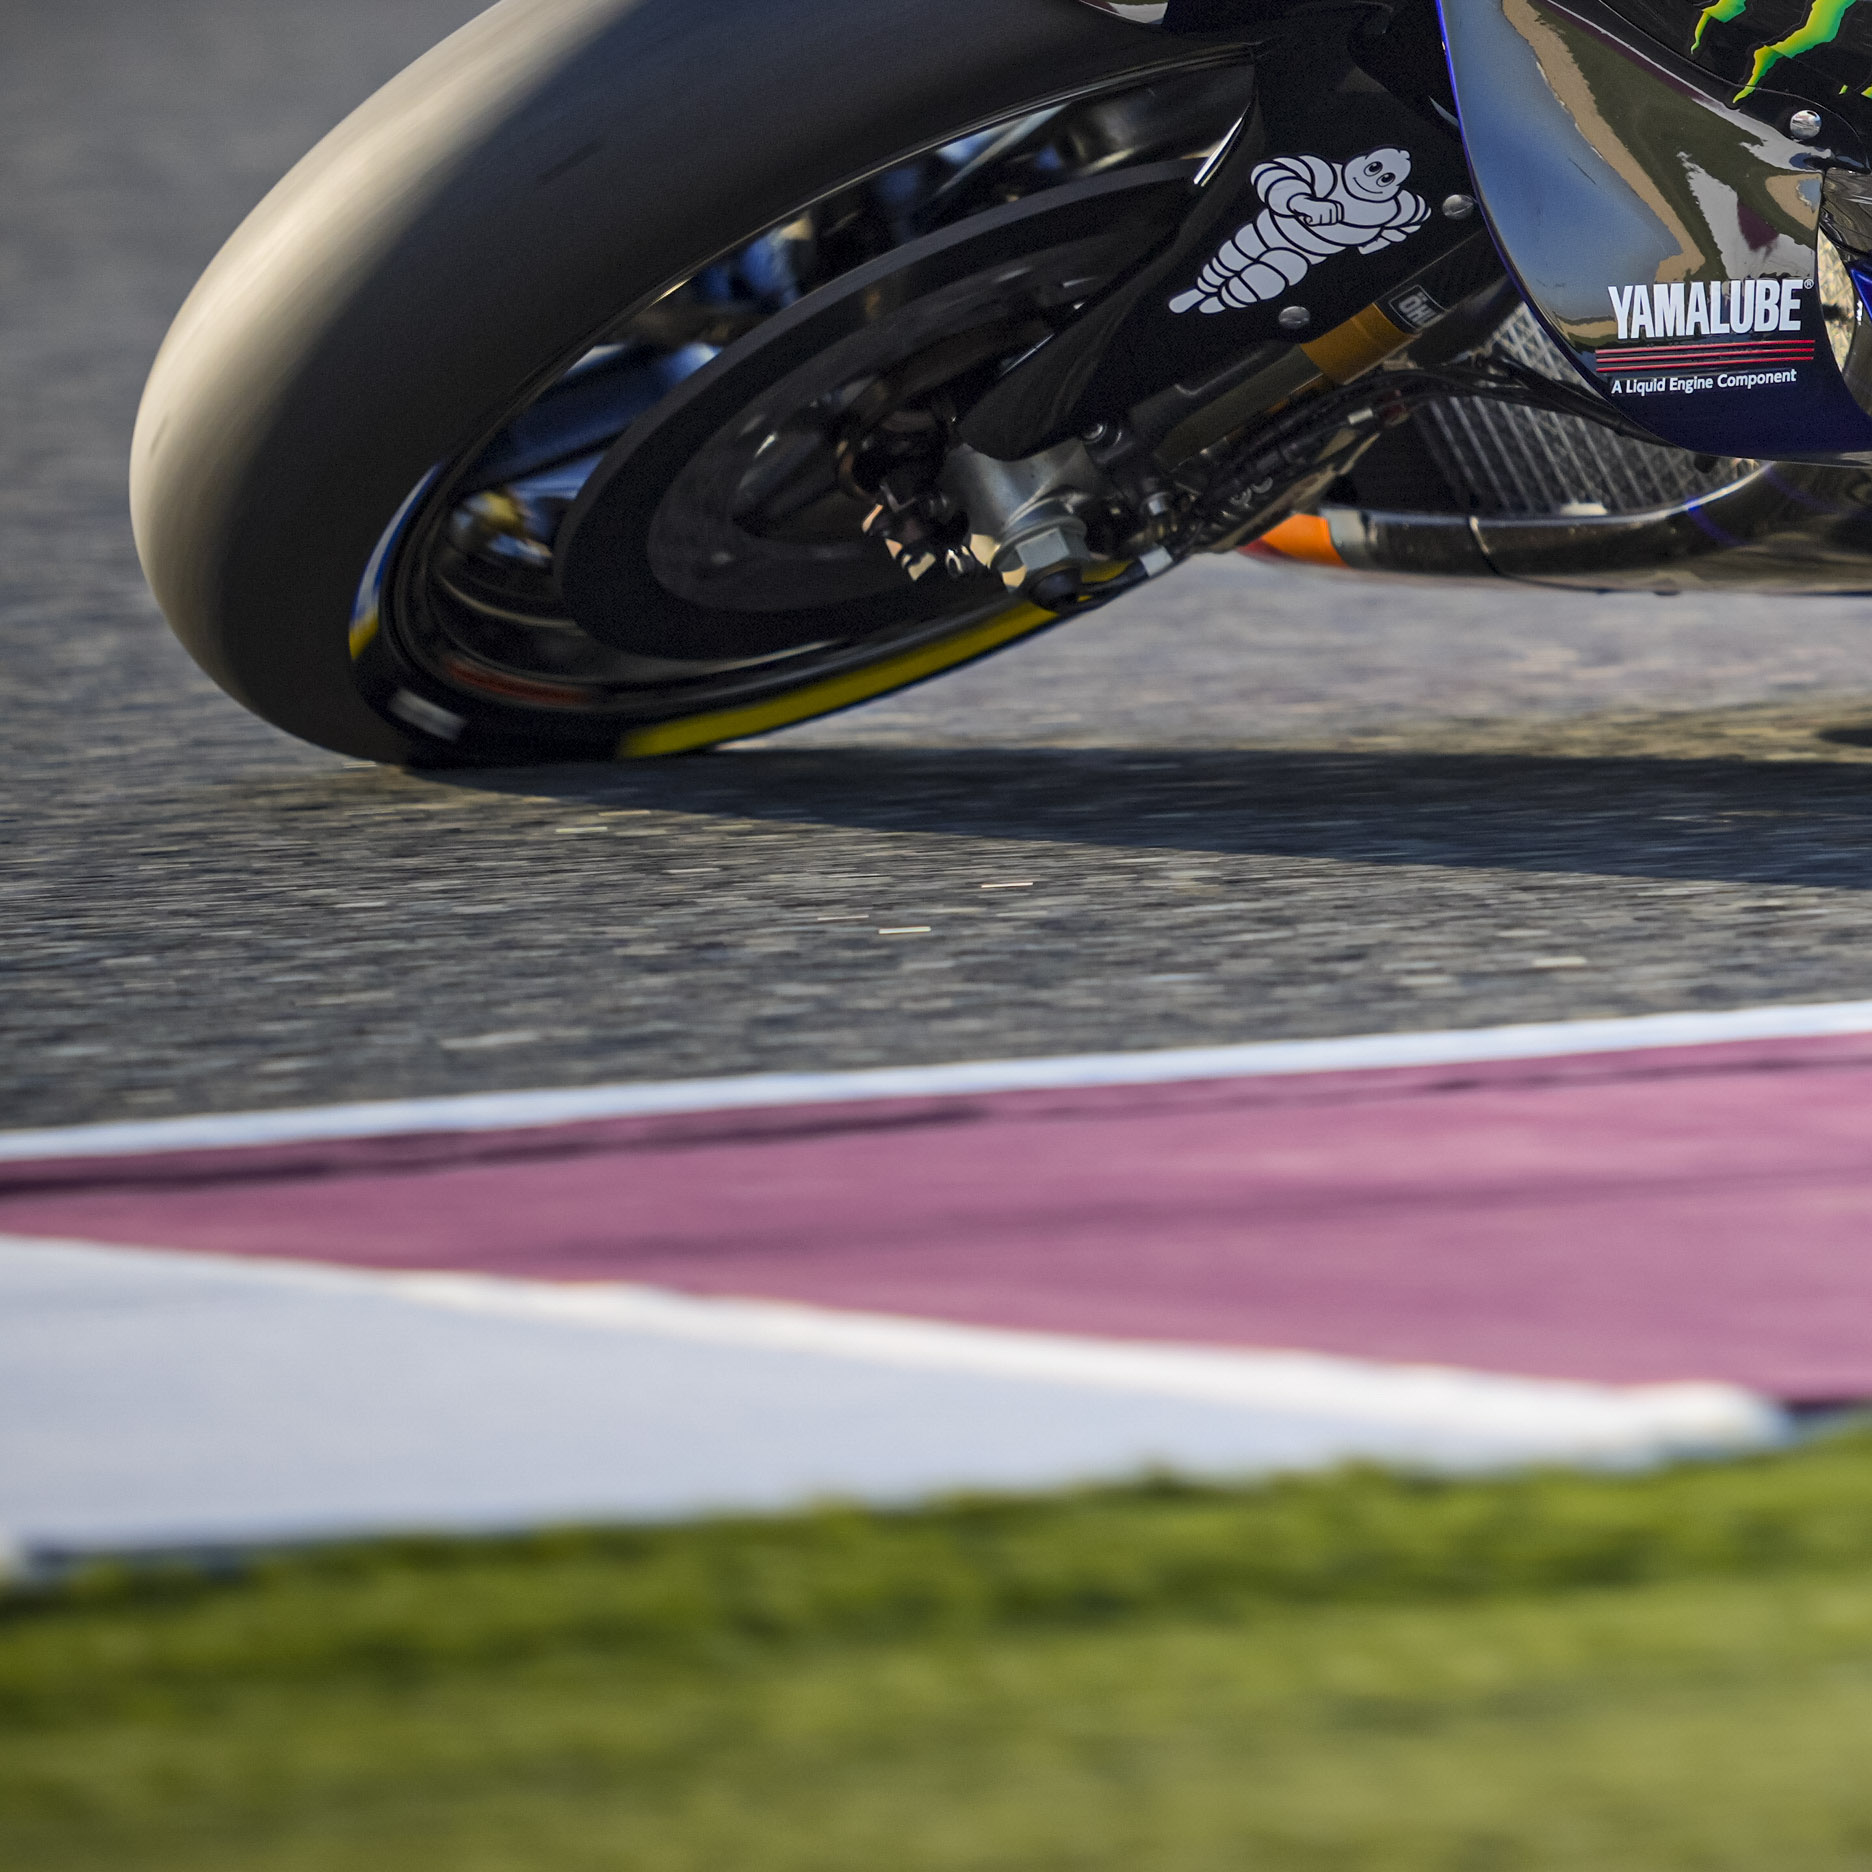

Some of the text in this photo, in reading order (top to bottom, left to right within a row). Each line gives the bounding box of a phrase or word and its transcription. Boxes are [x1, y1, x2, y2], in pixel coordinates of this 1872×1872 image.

[1608, 279, 1804, 340] YAMALUBE
[1611, 368, 1797, 397] A Liquid Engine Component
